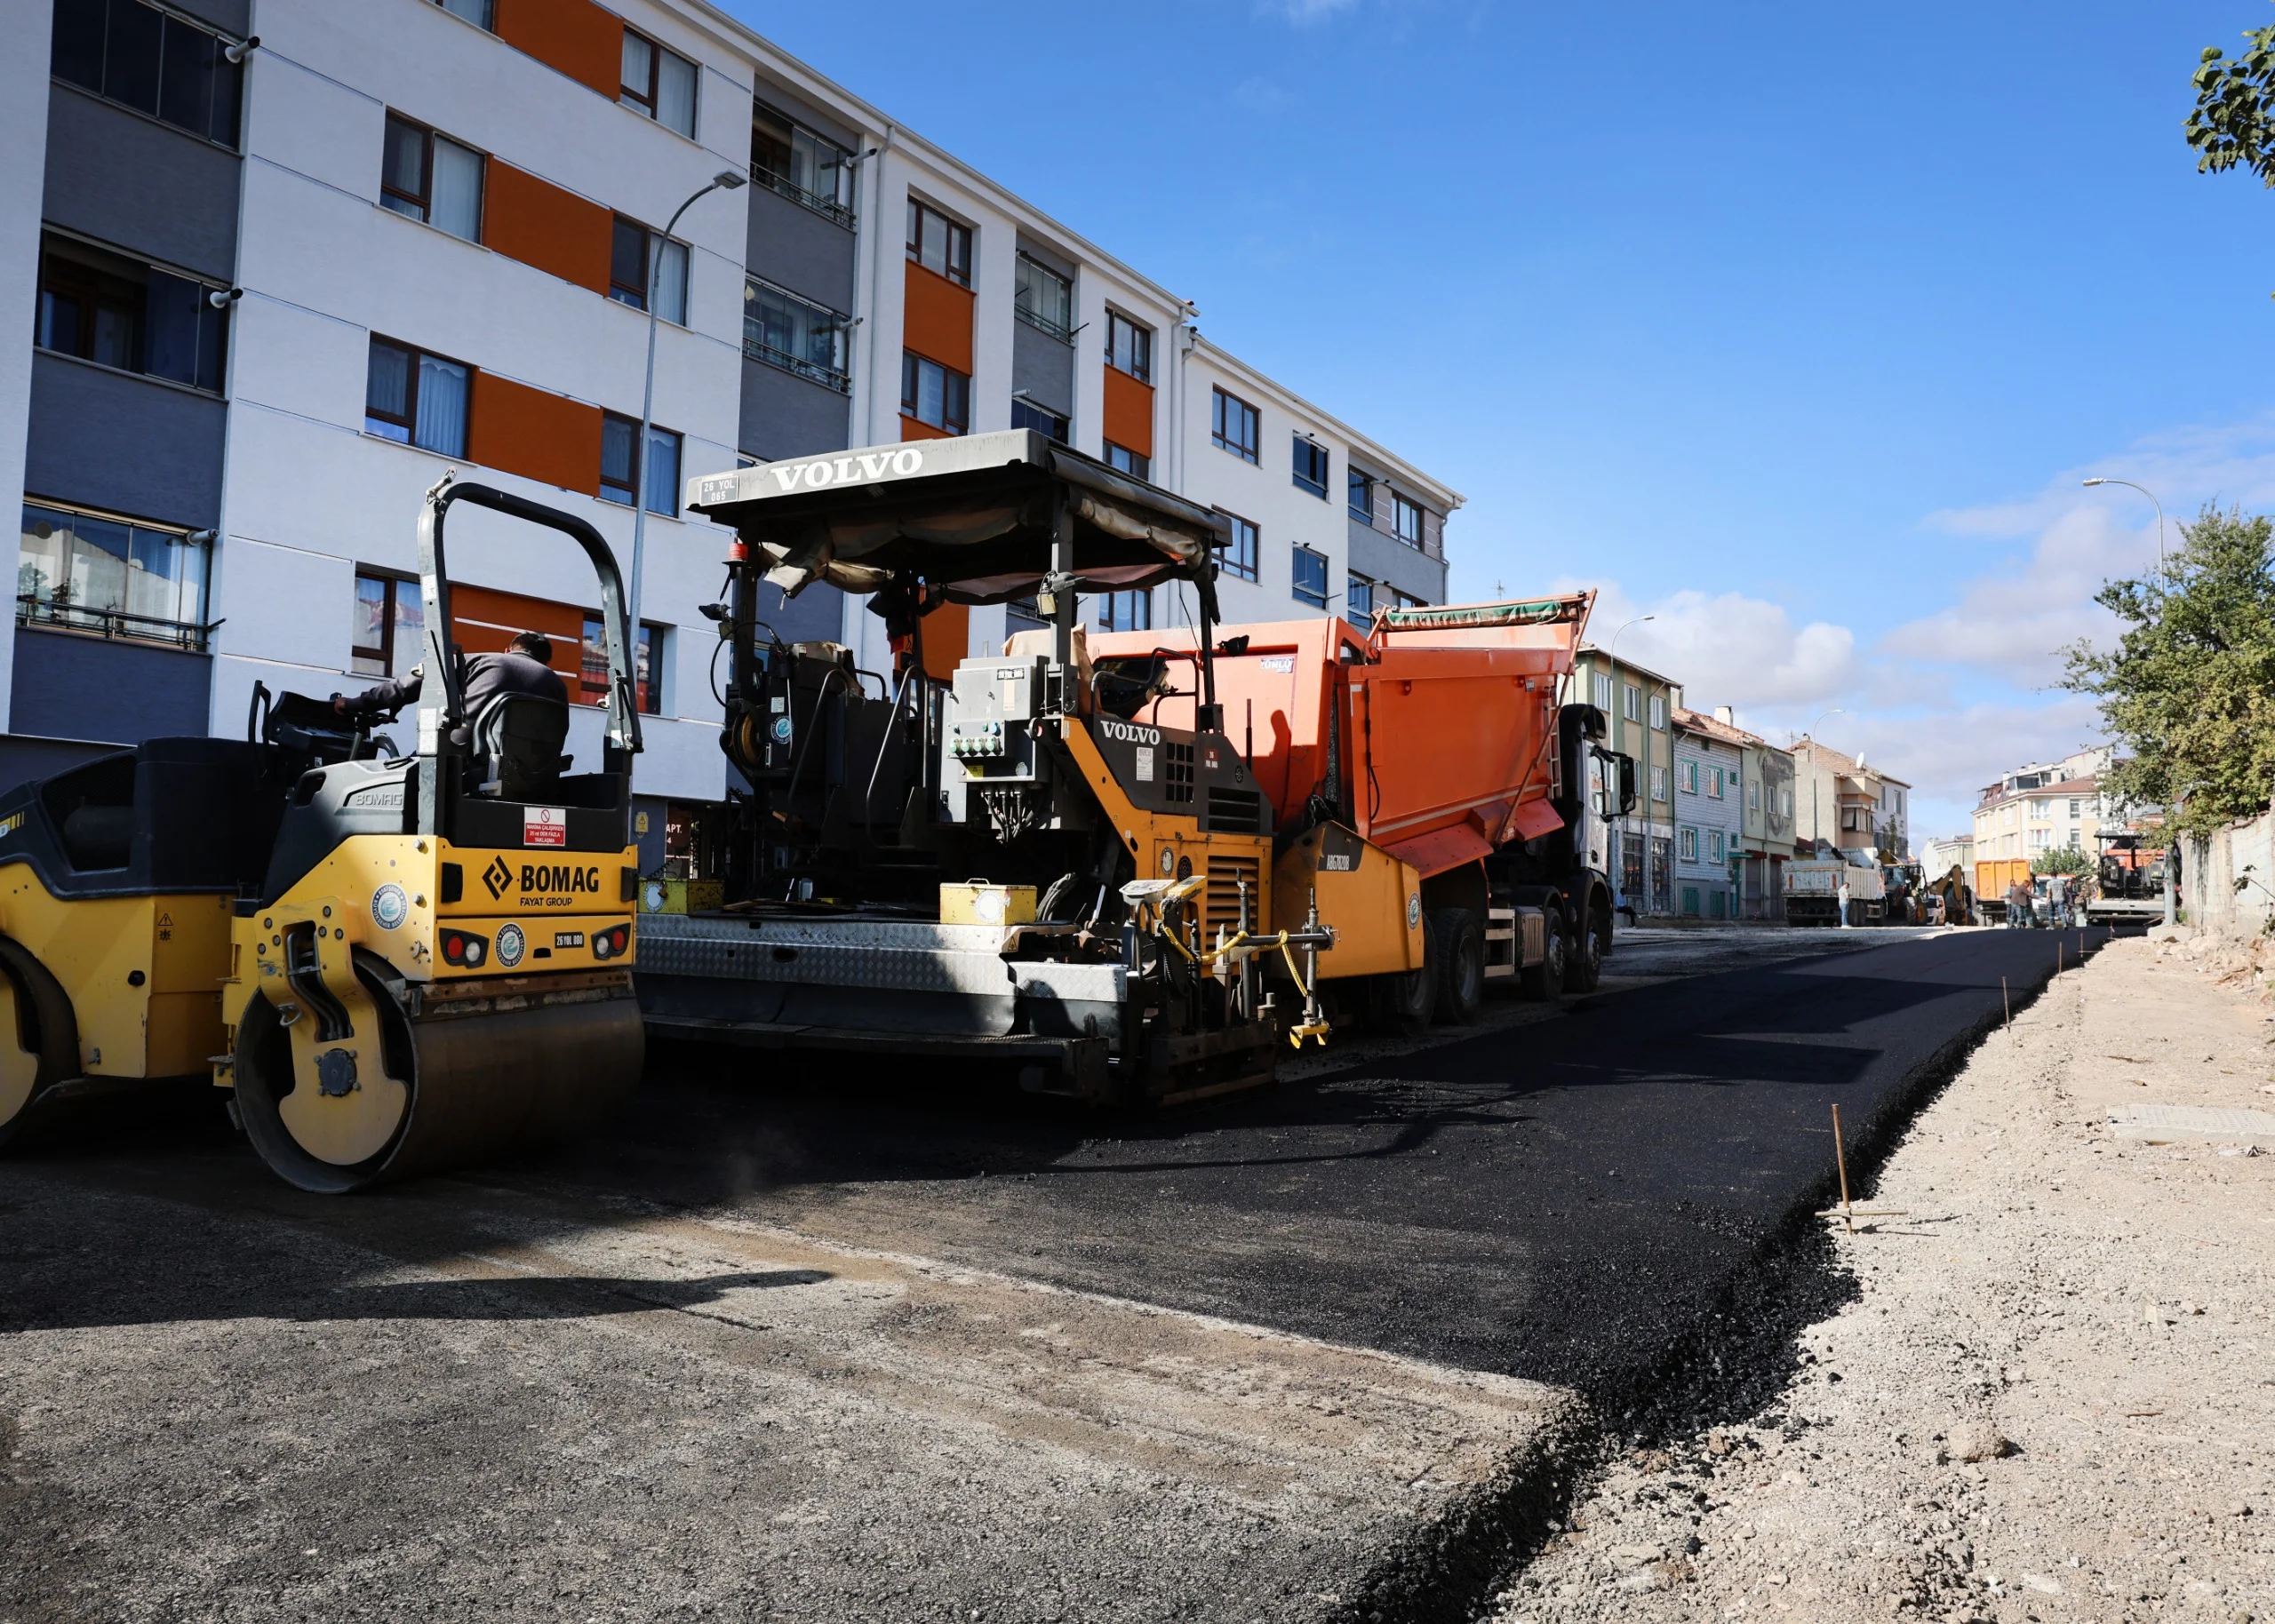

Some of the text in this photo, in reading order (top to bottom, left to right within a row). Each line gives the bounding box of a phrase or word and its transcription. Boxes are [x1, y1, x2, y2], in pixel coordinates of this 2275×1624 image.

[770, 449, 923, 490] VOLVO
[704, 479, 736, 492] 26 YOL
[711, 491, 726, 502] 065
[1100, 720, 1161, 745] VOLVO
[356, 792, 403, 806] BOMAG
[520, 864, 599, 893] BOMAG
[520, 897, 572, 906] FAYAT GROUP
[556, 935, 563, 946] 26
[563, 935, 572, 945] YOL
